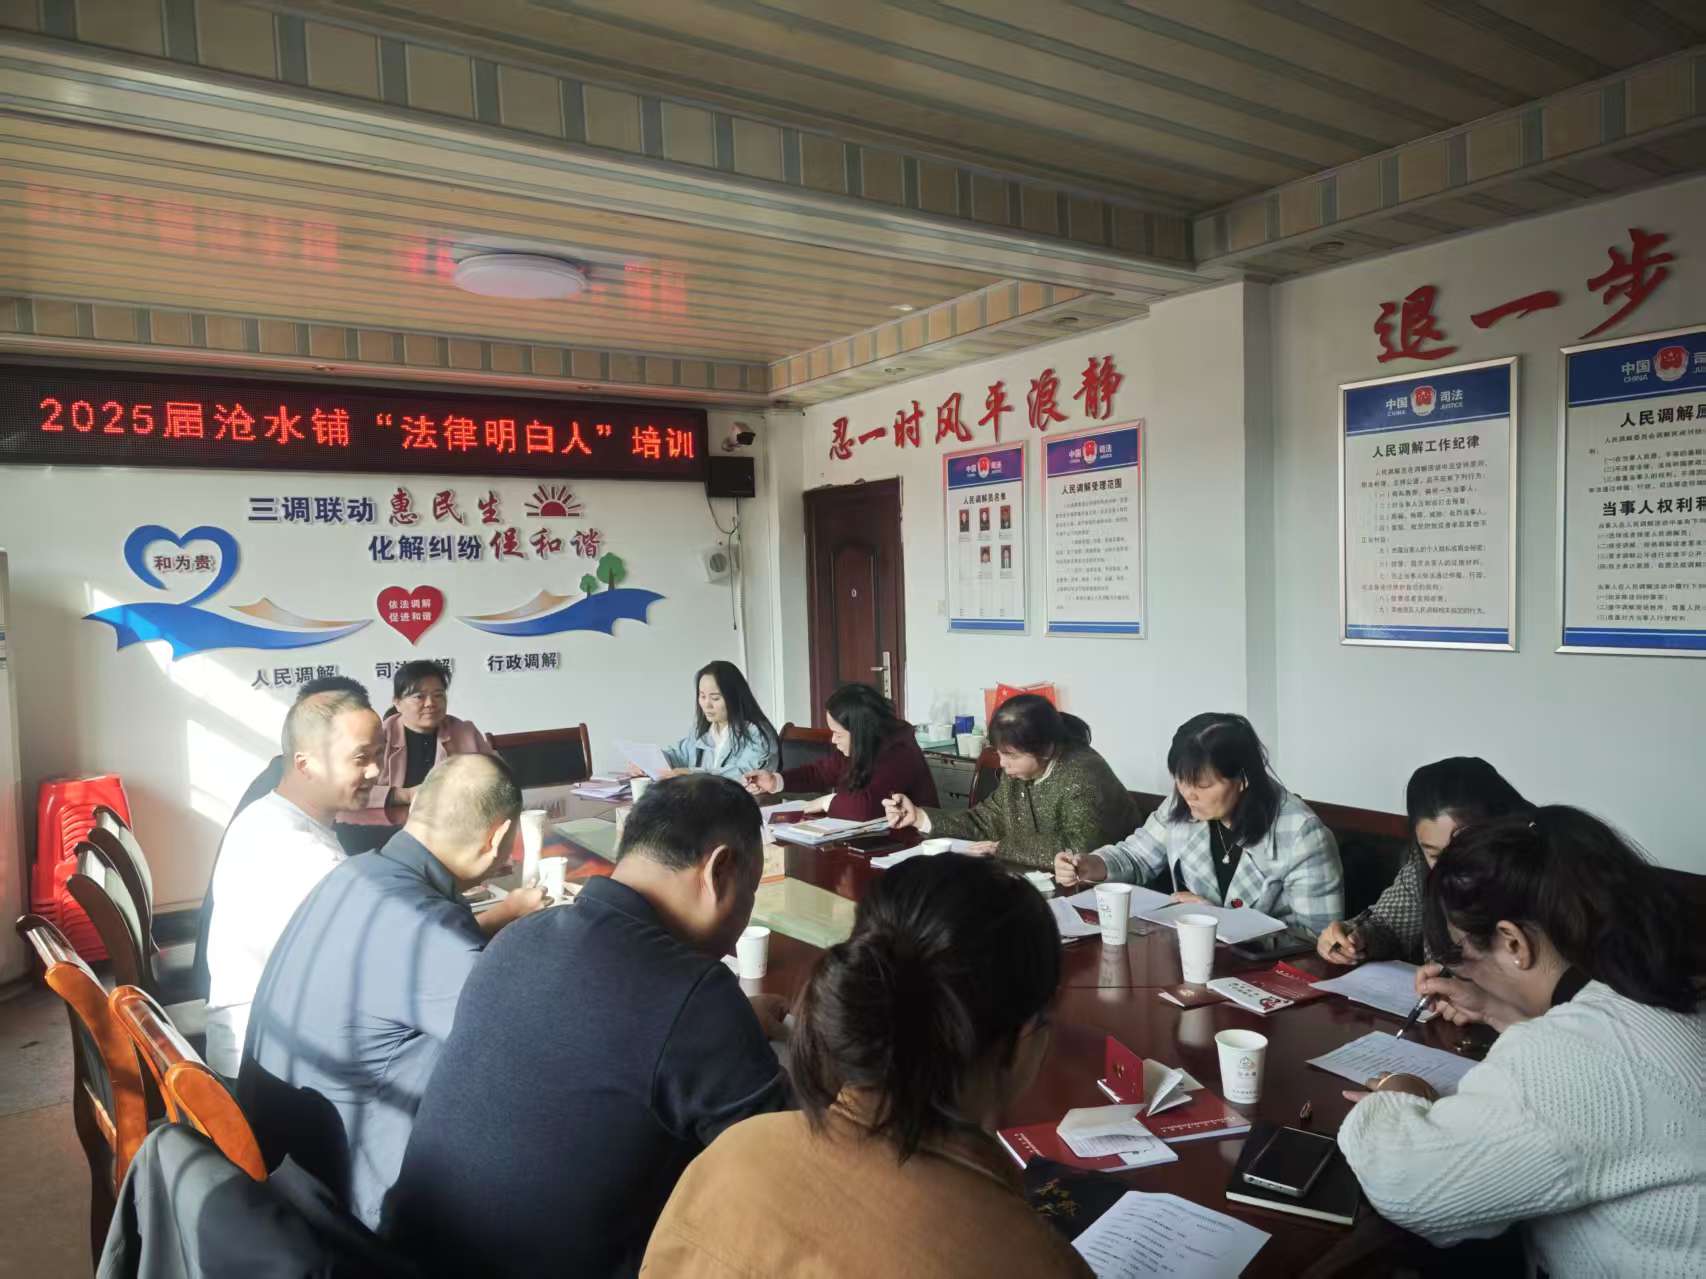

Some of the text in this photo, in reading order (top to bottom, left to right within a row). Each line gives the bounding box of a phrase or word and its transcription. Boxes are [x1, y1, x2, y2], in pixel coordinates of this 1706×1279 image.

[1374, 227, 1676, 362] 退一步
[1620, 359, 1650, 375] 中国
[829, 353, 1124, 461] 忍一时风平浪静
[1385, 389, 1463, 410] 中国 司法
[1372, 434, 1480, 458] 人民调解工作纪律
[1062, 478, 1122, 496] 人民调解受理范围
[154, 554, 212, 571] 和为贵
[388, 599, 432, 610] 依法调解
[388, 611, 432, 623] 促进和谐
[487, 652, 557, 672] 行政调解
[251, 665, 335, 687] 人民调解
